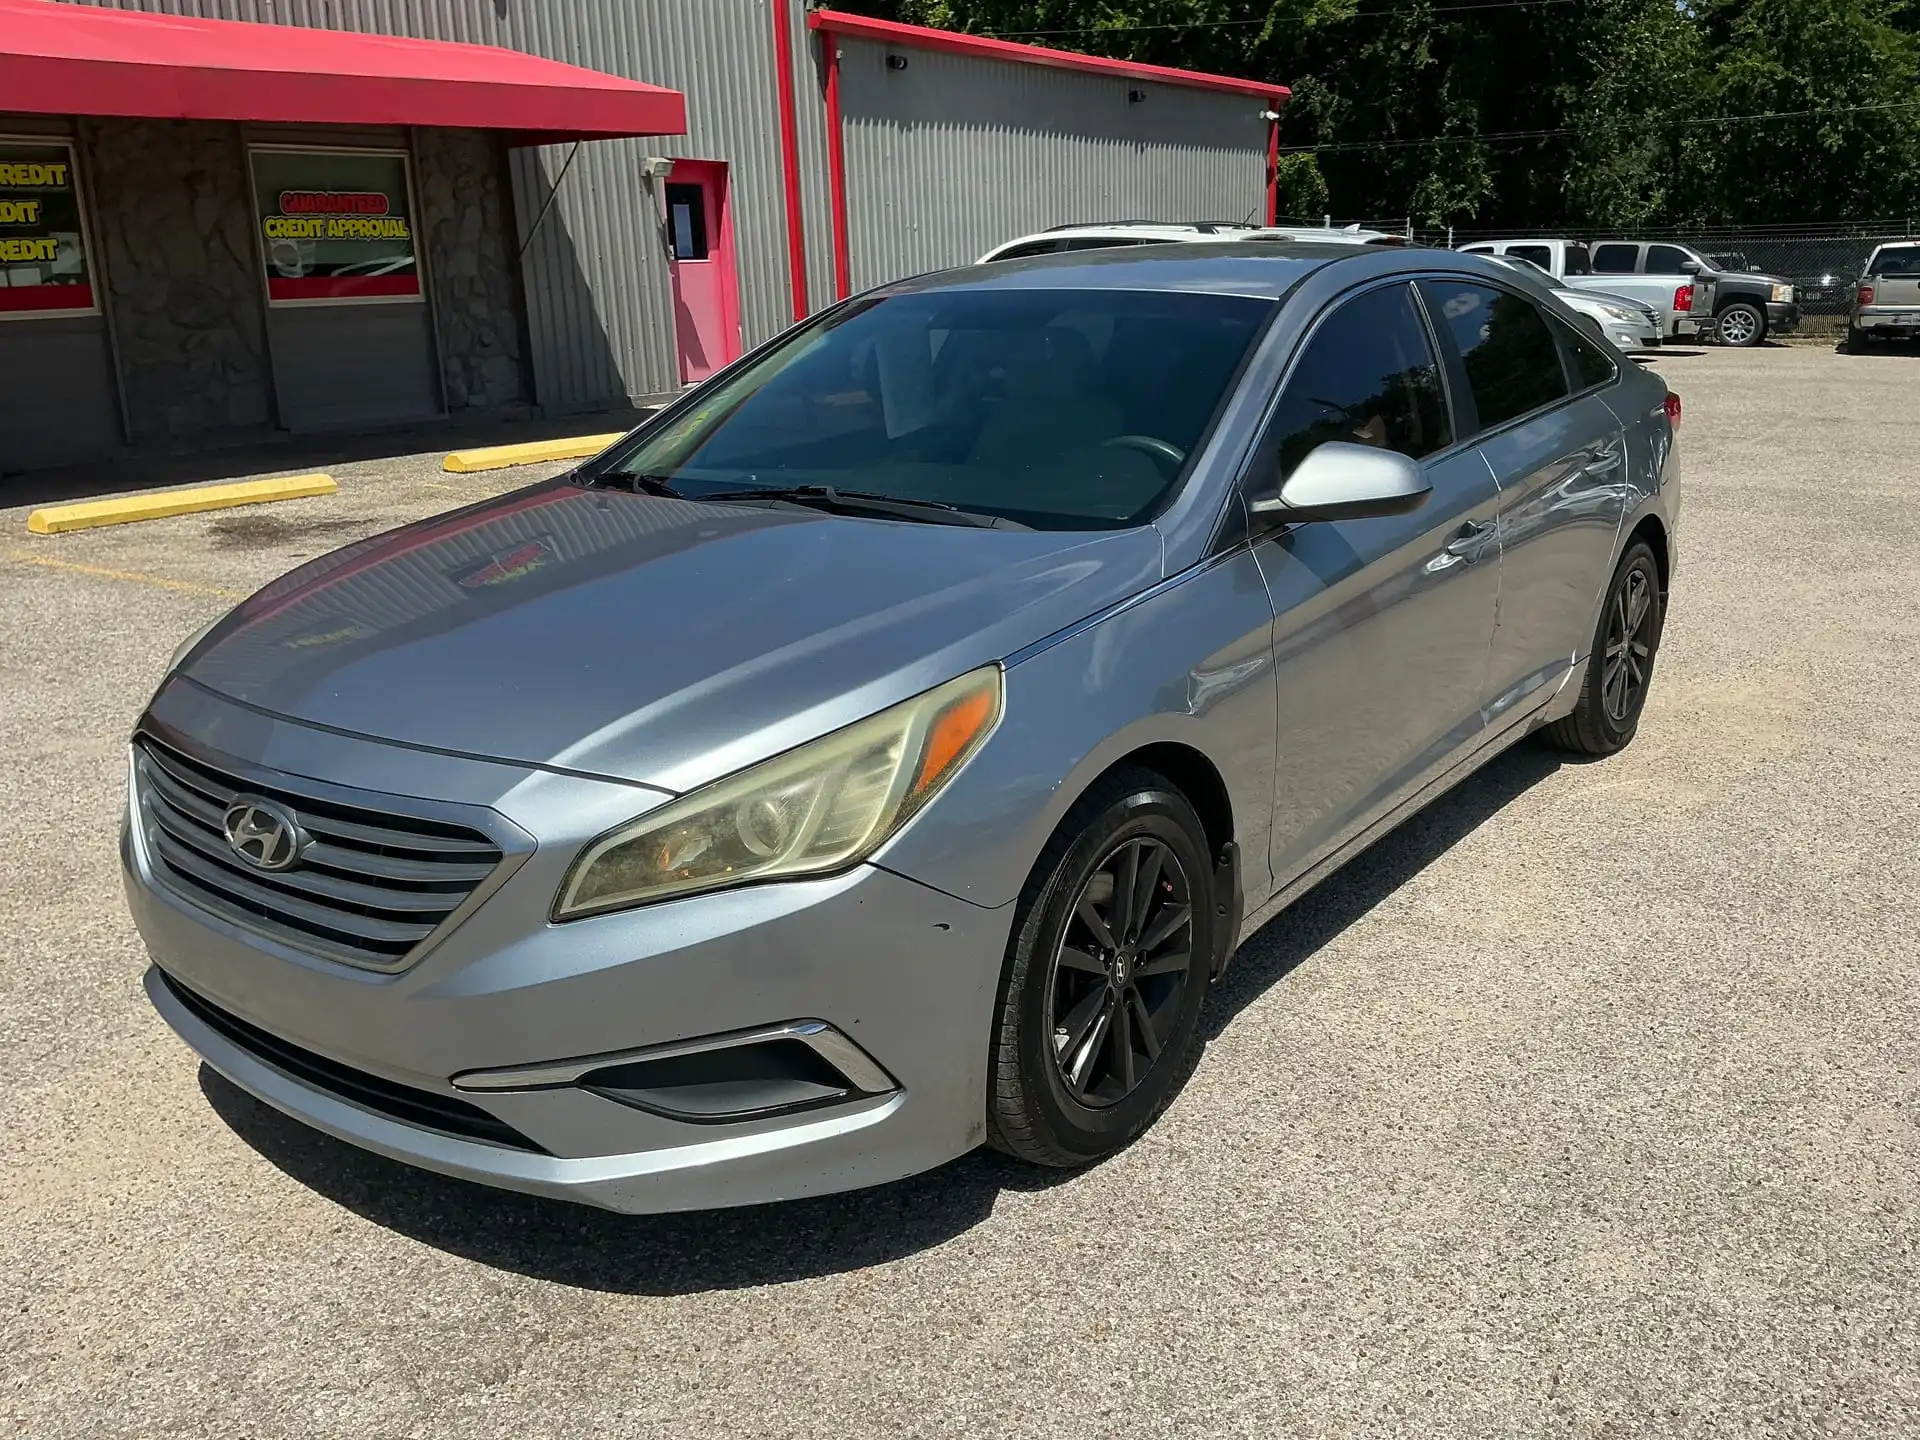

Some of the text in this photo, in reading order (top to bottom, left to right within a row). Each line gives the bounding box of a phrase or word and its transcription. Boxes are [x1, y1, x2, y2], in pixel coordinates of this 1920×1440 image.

[0, 201, 39, 223] DIT
[281, 192, 387, 214] GUARANTEED
[264, 217, 410, 239] CREDIT APPROVAL
